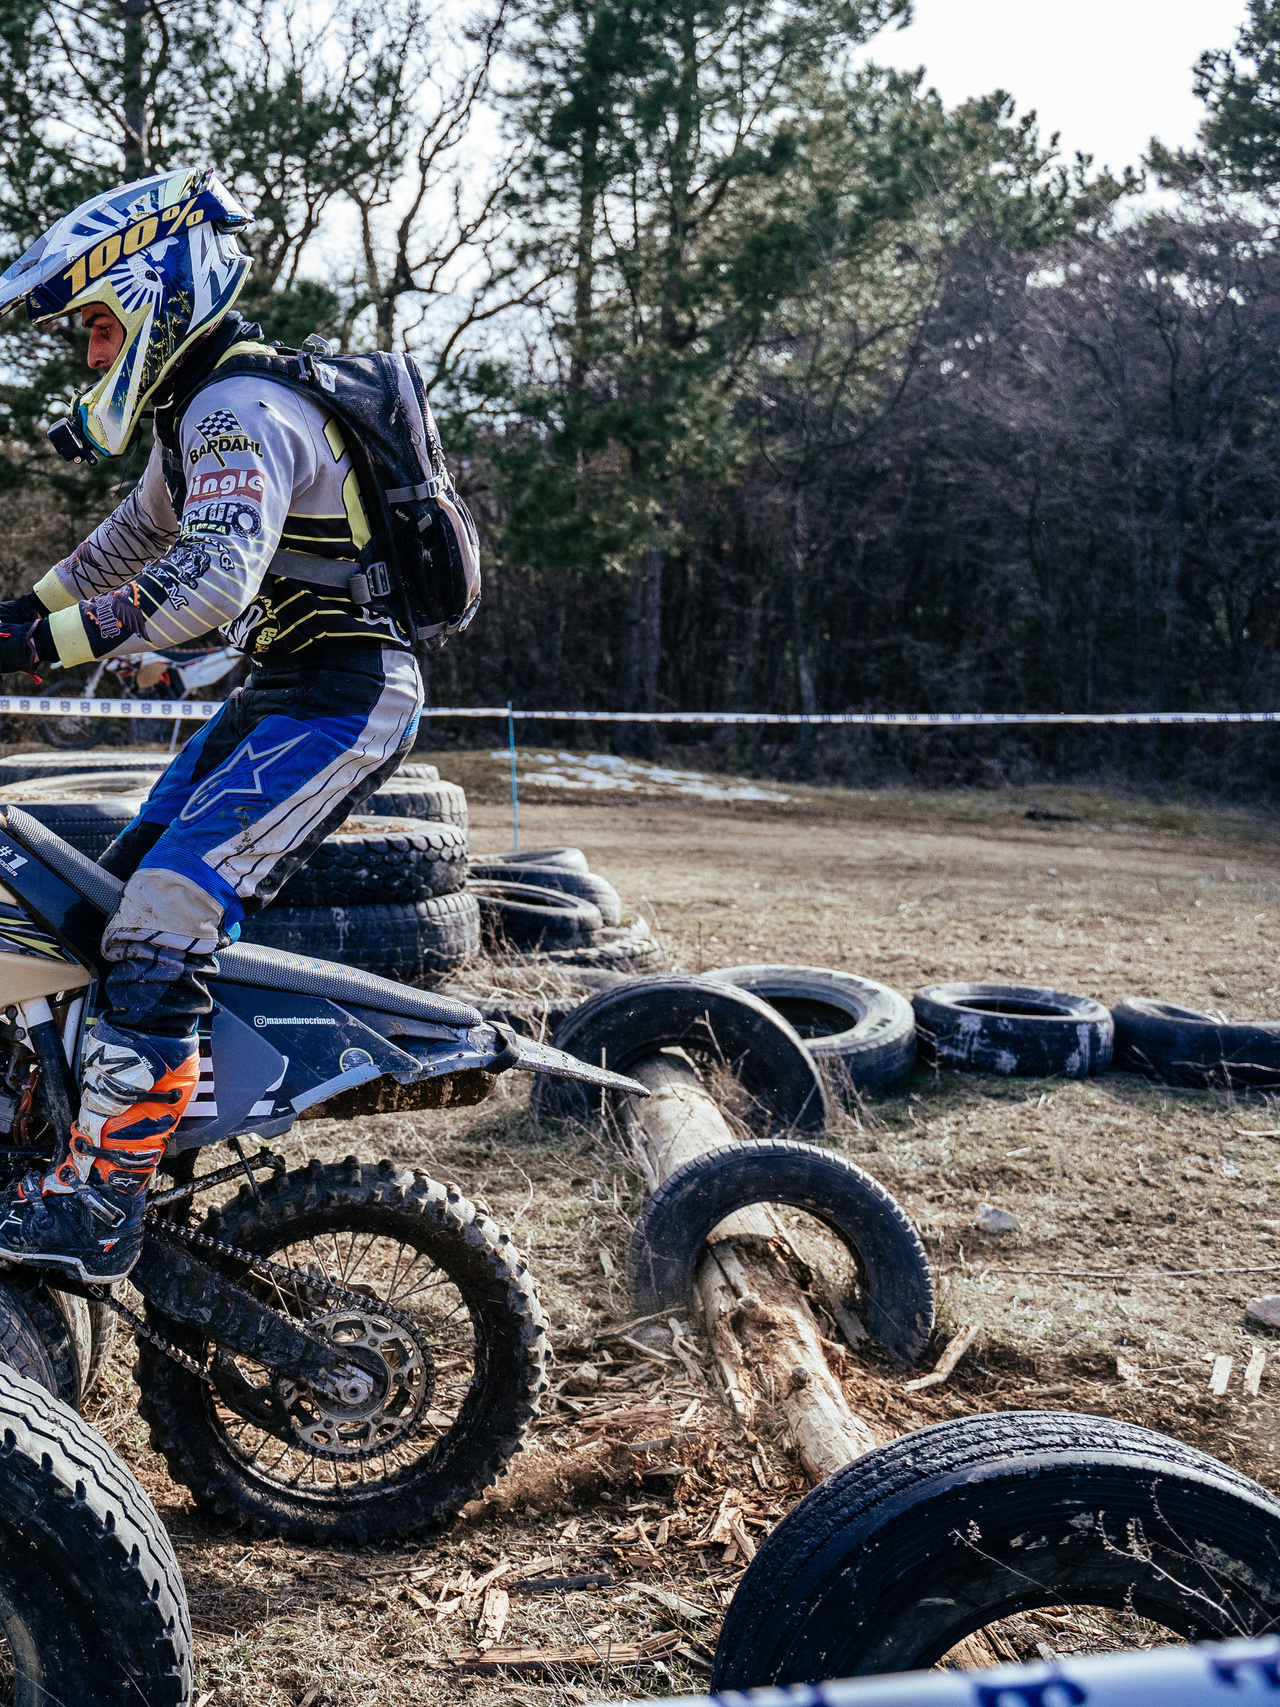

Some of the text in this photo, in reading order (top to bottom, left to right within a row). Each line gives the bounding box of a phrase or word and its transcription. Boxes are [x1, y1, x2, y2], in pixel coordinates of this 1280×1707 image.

[64, 197, 205, 296] 100%
[189, 437, 264, 466] BARDAHL
[266, 1016, 336, 1025] maxendurocrimea
[103, 1243, 116, 1253] 7
